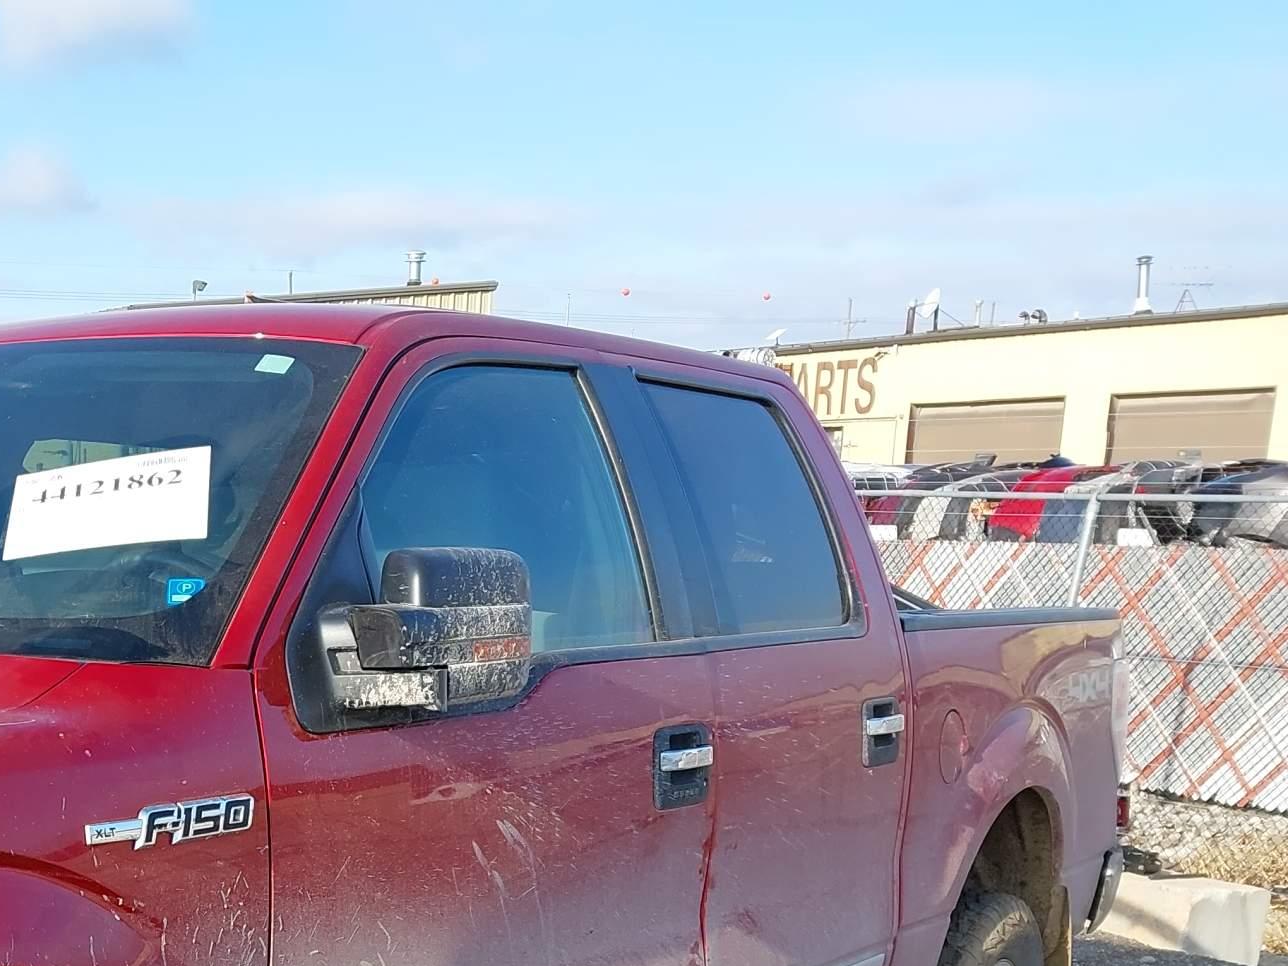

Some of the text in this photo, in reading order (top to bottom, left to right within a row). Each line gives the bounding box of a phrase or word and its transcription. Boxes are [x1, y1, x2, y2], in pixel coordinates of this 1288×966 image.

[31, 468, 183, 504] 44121862
[94, 792, 255, 851] XLT F-150
